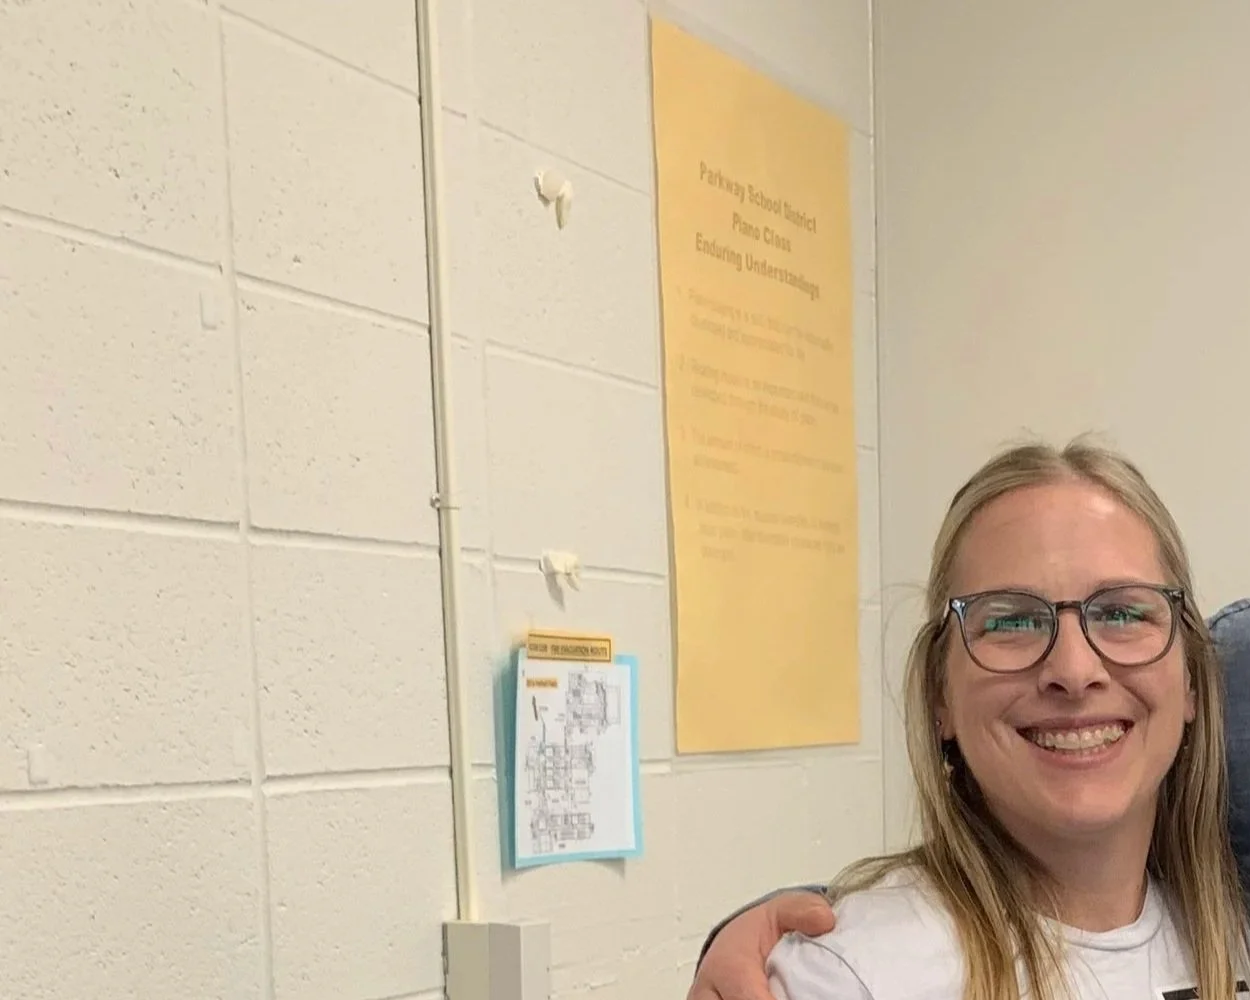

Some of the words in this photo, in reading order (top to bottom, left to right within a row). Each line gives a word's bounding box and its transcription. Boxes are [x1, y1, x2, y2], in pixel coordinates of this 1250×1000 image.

[700, 160, 745, 203] Parkway
[747, 184, 782, 215] School
[695, 232, 742, 272] Enduring
[732, 211, 760, 240] Piano
[763, 226, 791, 252] Class
